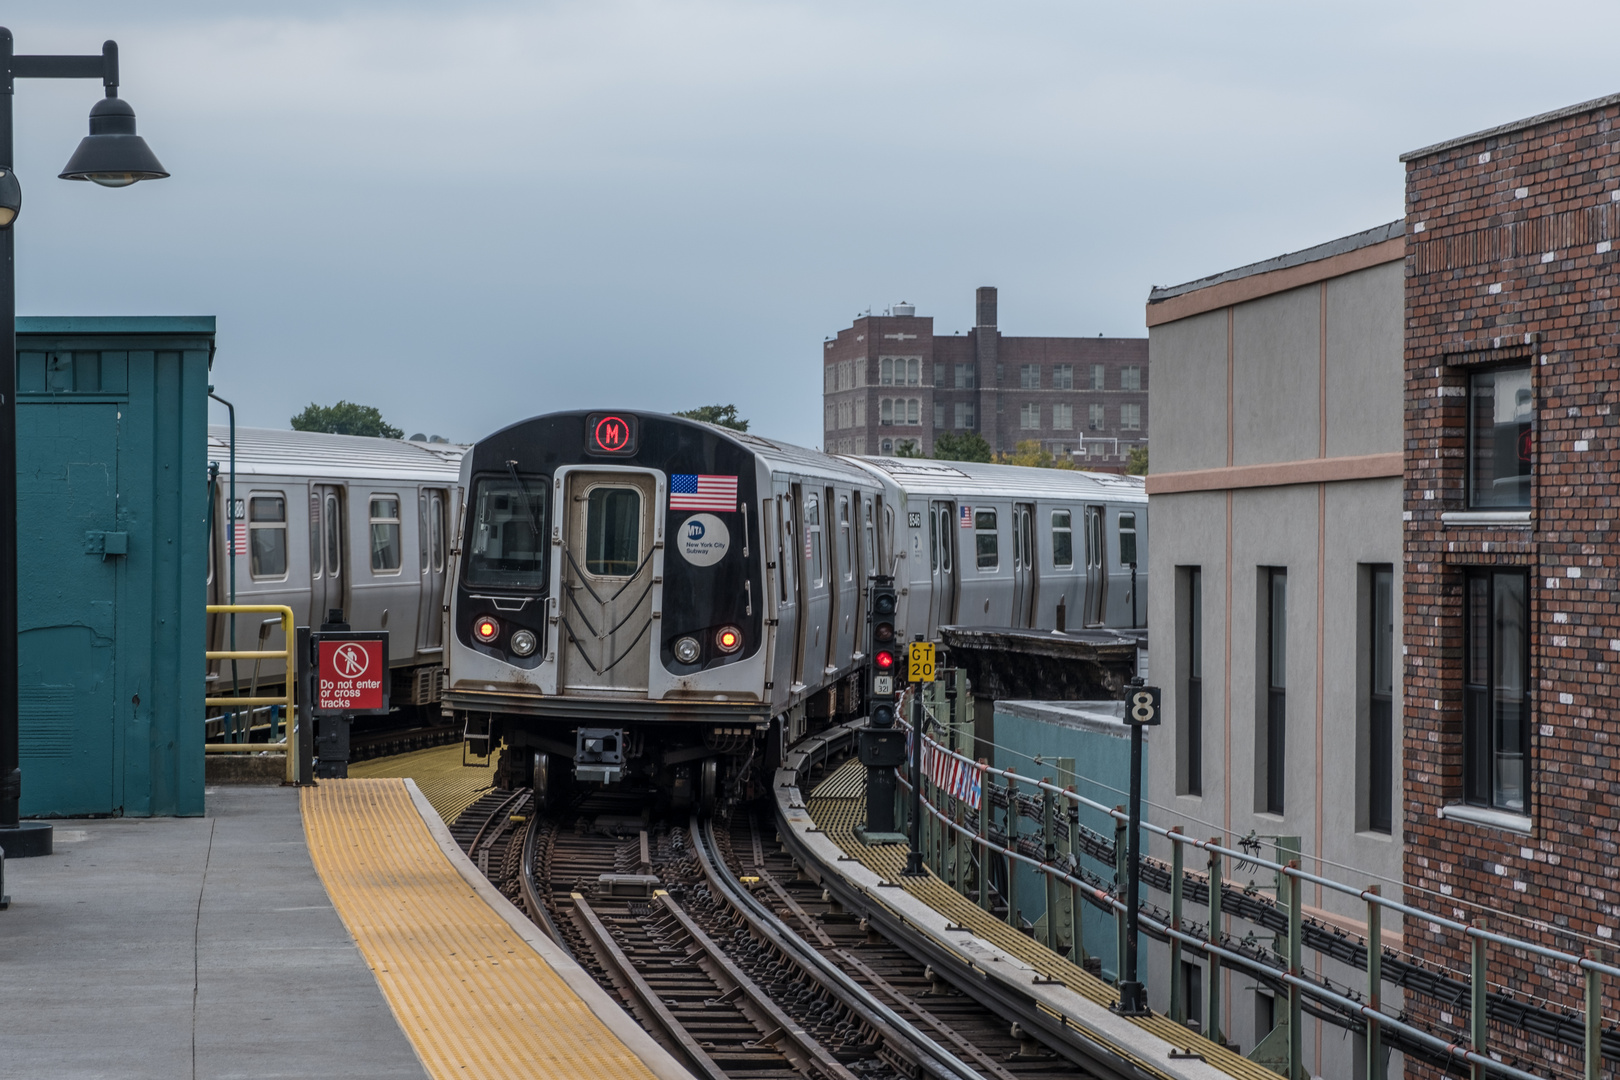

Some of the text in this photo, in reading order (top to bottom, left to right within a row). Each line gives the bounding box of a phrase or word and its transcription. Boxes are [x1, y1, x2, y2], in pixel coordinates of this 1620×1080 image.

[605, 423, 619, 444] M
[687, 525, 702, 537] MTA
[911, 648, 932, 661] GT
[911, 663, 932, 676] 20
[320, 679, 381, 689] Do not enter
[320, 689, 361, 697] or cross
[321, 698, 350, 708] tracks
[1131, 691, 1155, 722] 8
